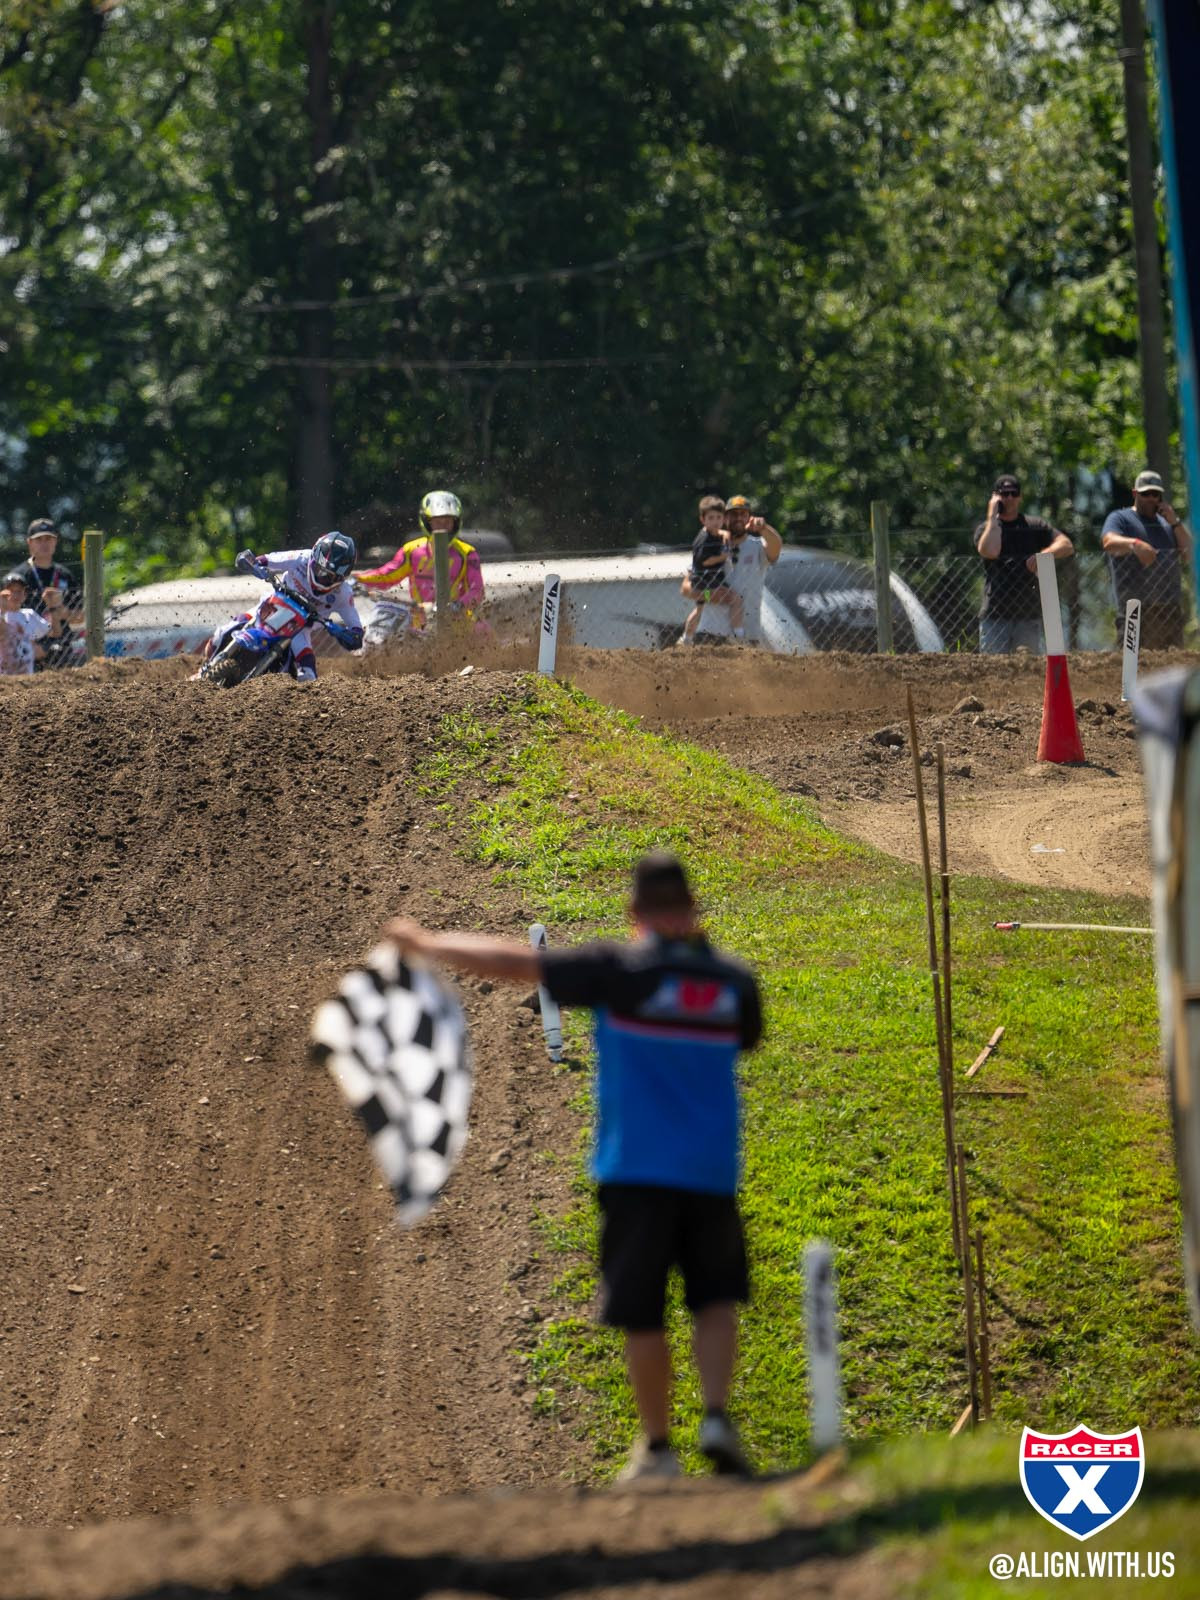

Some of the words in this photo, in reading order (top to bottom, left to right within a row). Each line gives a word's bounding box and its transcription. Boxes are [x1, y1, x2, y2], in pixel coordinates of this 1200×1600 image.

[264, 602, 298, 633] 1
[543, 596, 553, 634] UFO
[1126, 620, 1135, 651] UFO
